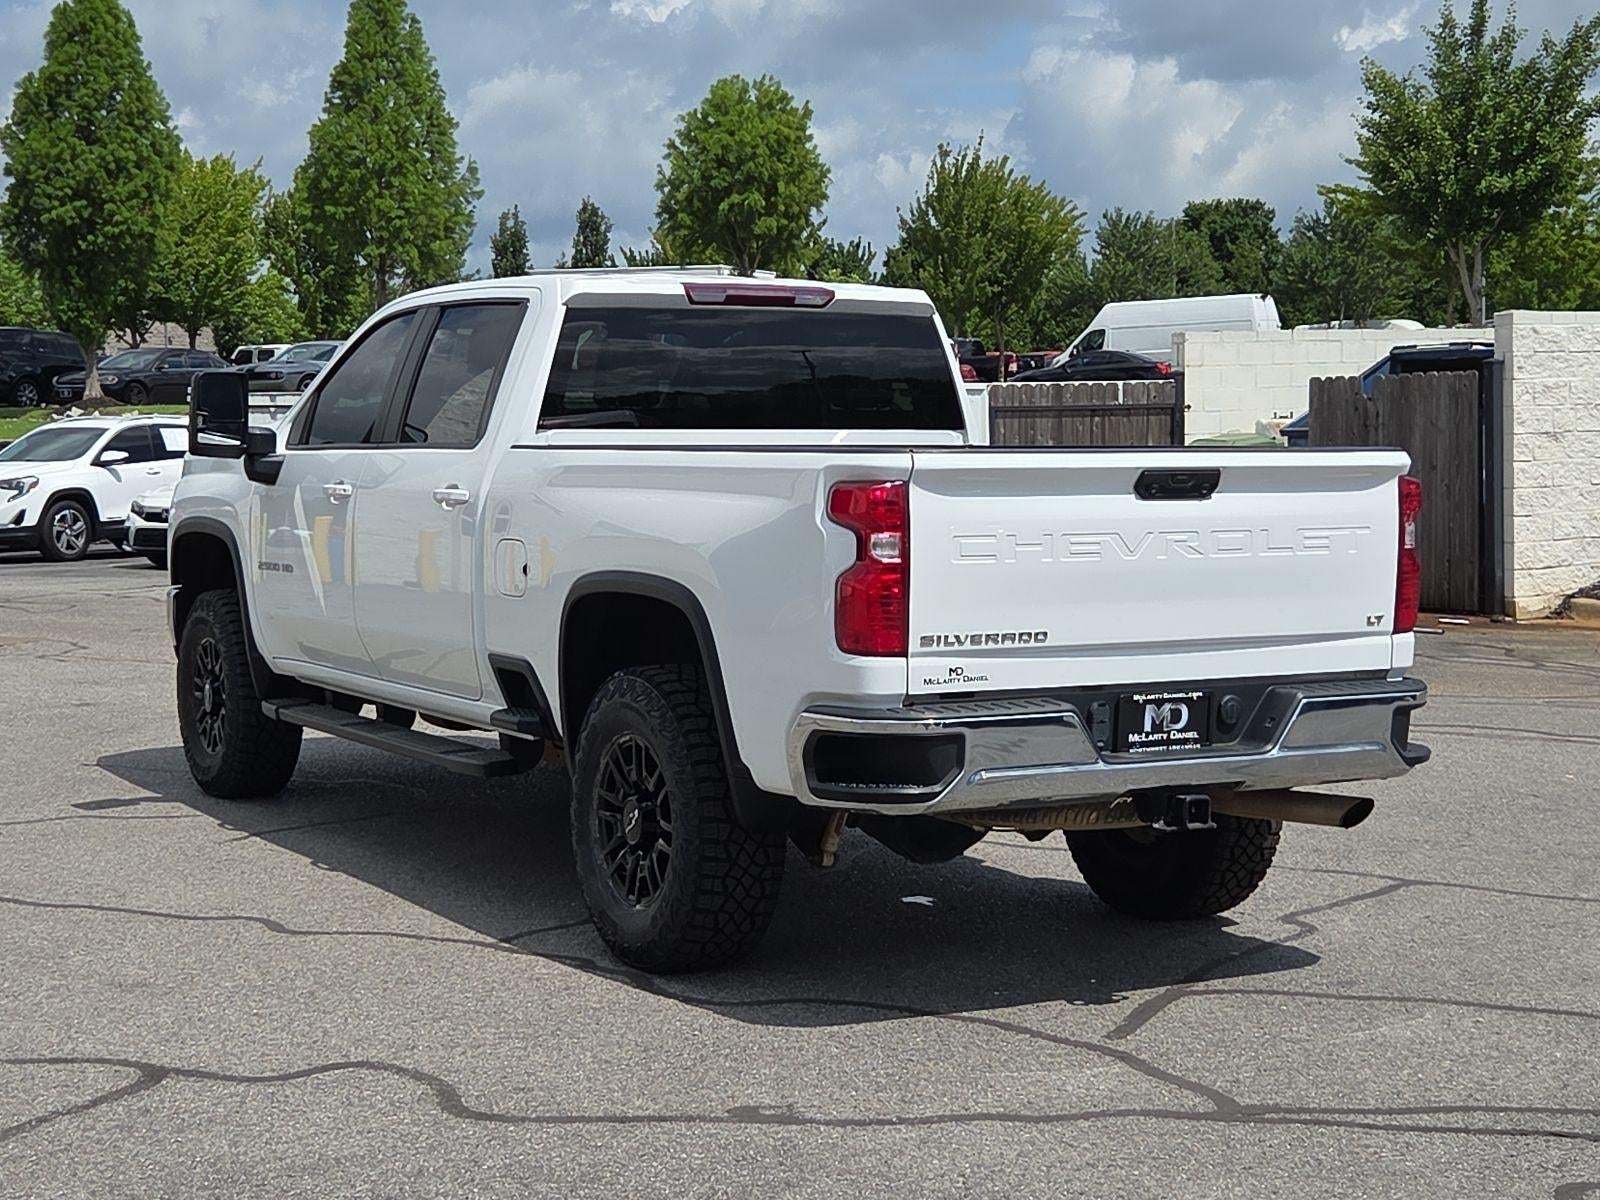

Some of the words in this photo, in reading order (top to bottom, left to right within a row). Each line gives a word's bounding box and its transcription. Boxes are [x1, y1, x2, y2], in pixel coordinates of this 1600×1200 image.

[950, 525, 1371, 563] CHEVROLET
[1366, 615, 1384, 627] LT
[920, 631, 1048, 648] SILVERADO
[949, 667, 963, 676] MD
[1143, 702, 1189, 732] MD
